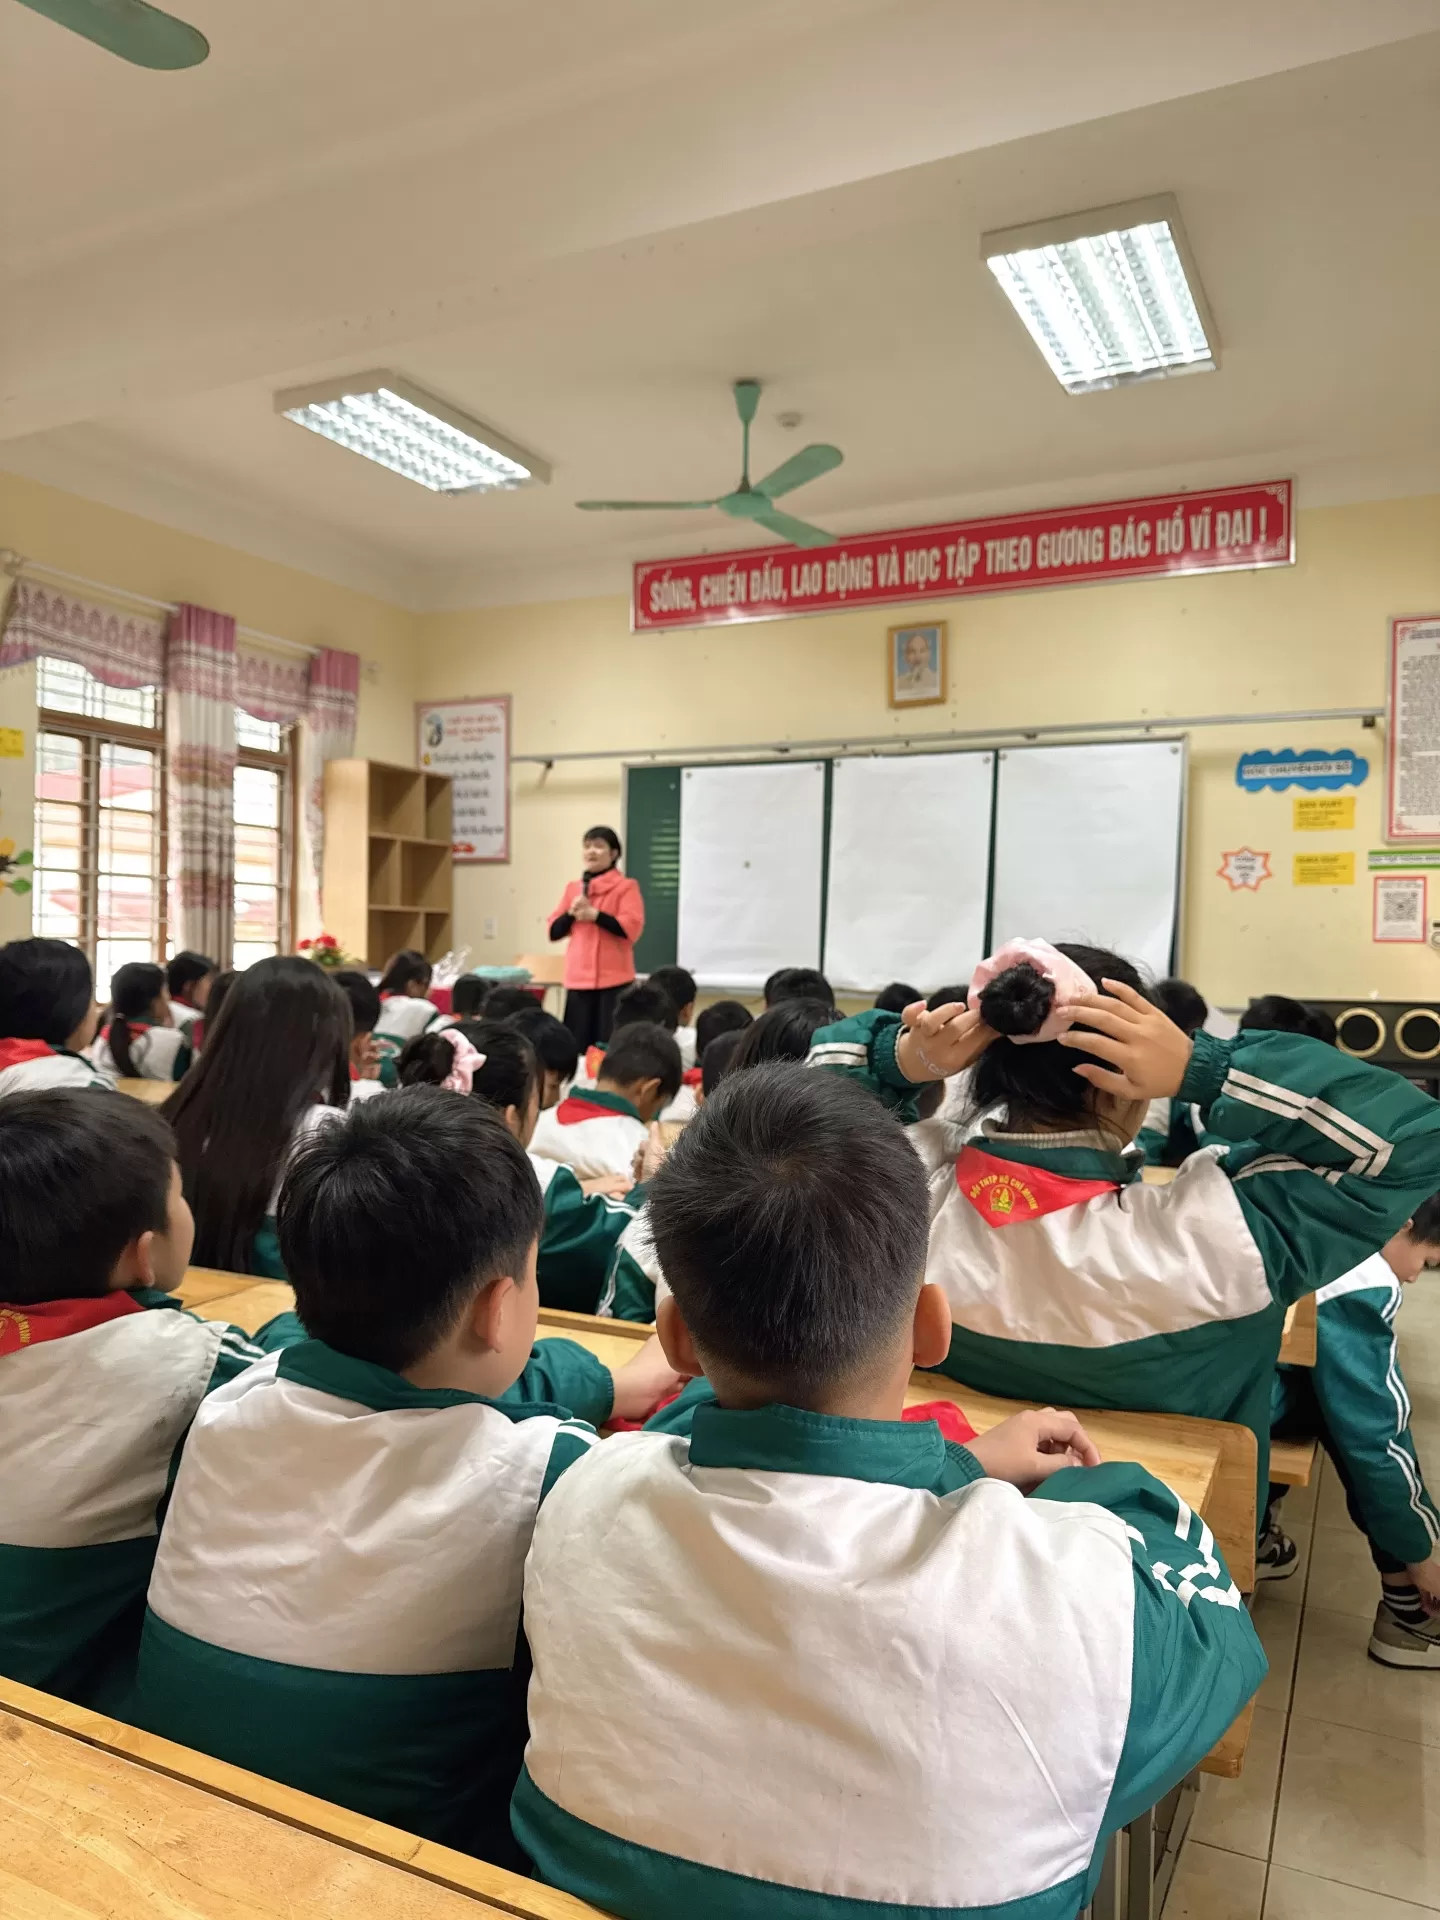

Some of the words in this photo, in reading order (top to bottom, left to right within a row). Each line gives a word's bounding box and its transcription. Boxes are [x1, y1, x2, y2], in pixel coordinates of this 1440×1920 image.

[700, 562, 747, 608] CHIẾN
[750, 556, 787, 603] ĐẤU,
[791, 562, 822, 597] LAO
[825, 551, 873, 599] ĐỘNG
[877, 545, 900, 588] VÀ
[903, 547, 941, 590] HỌC
[944, 536, 981, 586] TẬP
[984, 535, 1032, 575] THEO
[1036, 525, 1104, 569] GƯƠNG
[1109, 515, 1151, 560] BÁC
[1216, 508, 1252, 554] ĐẠI
